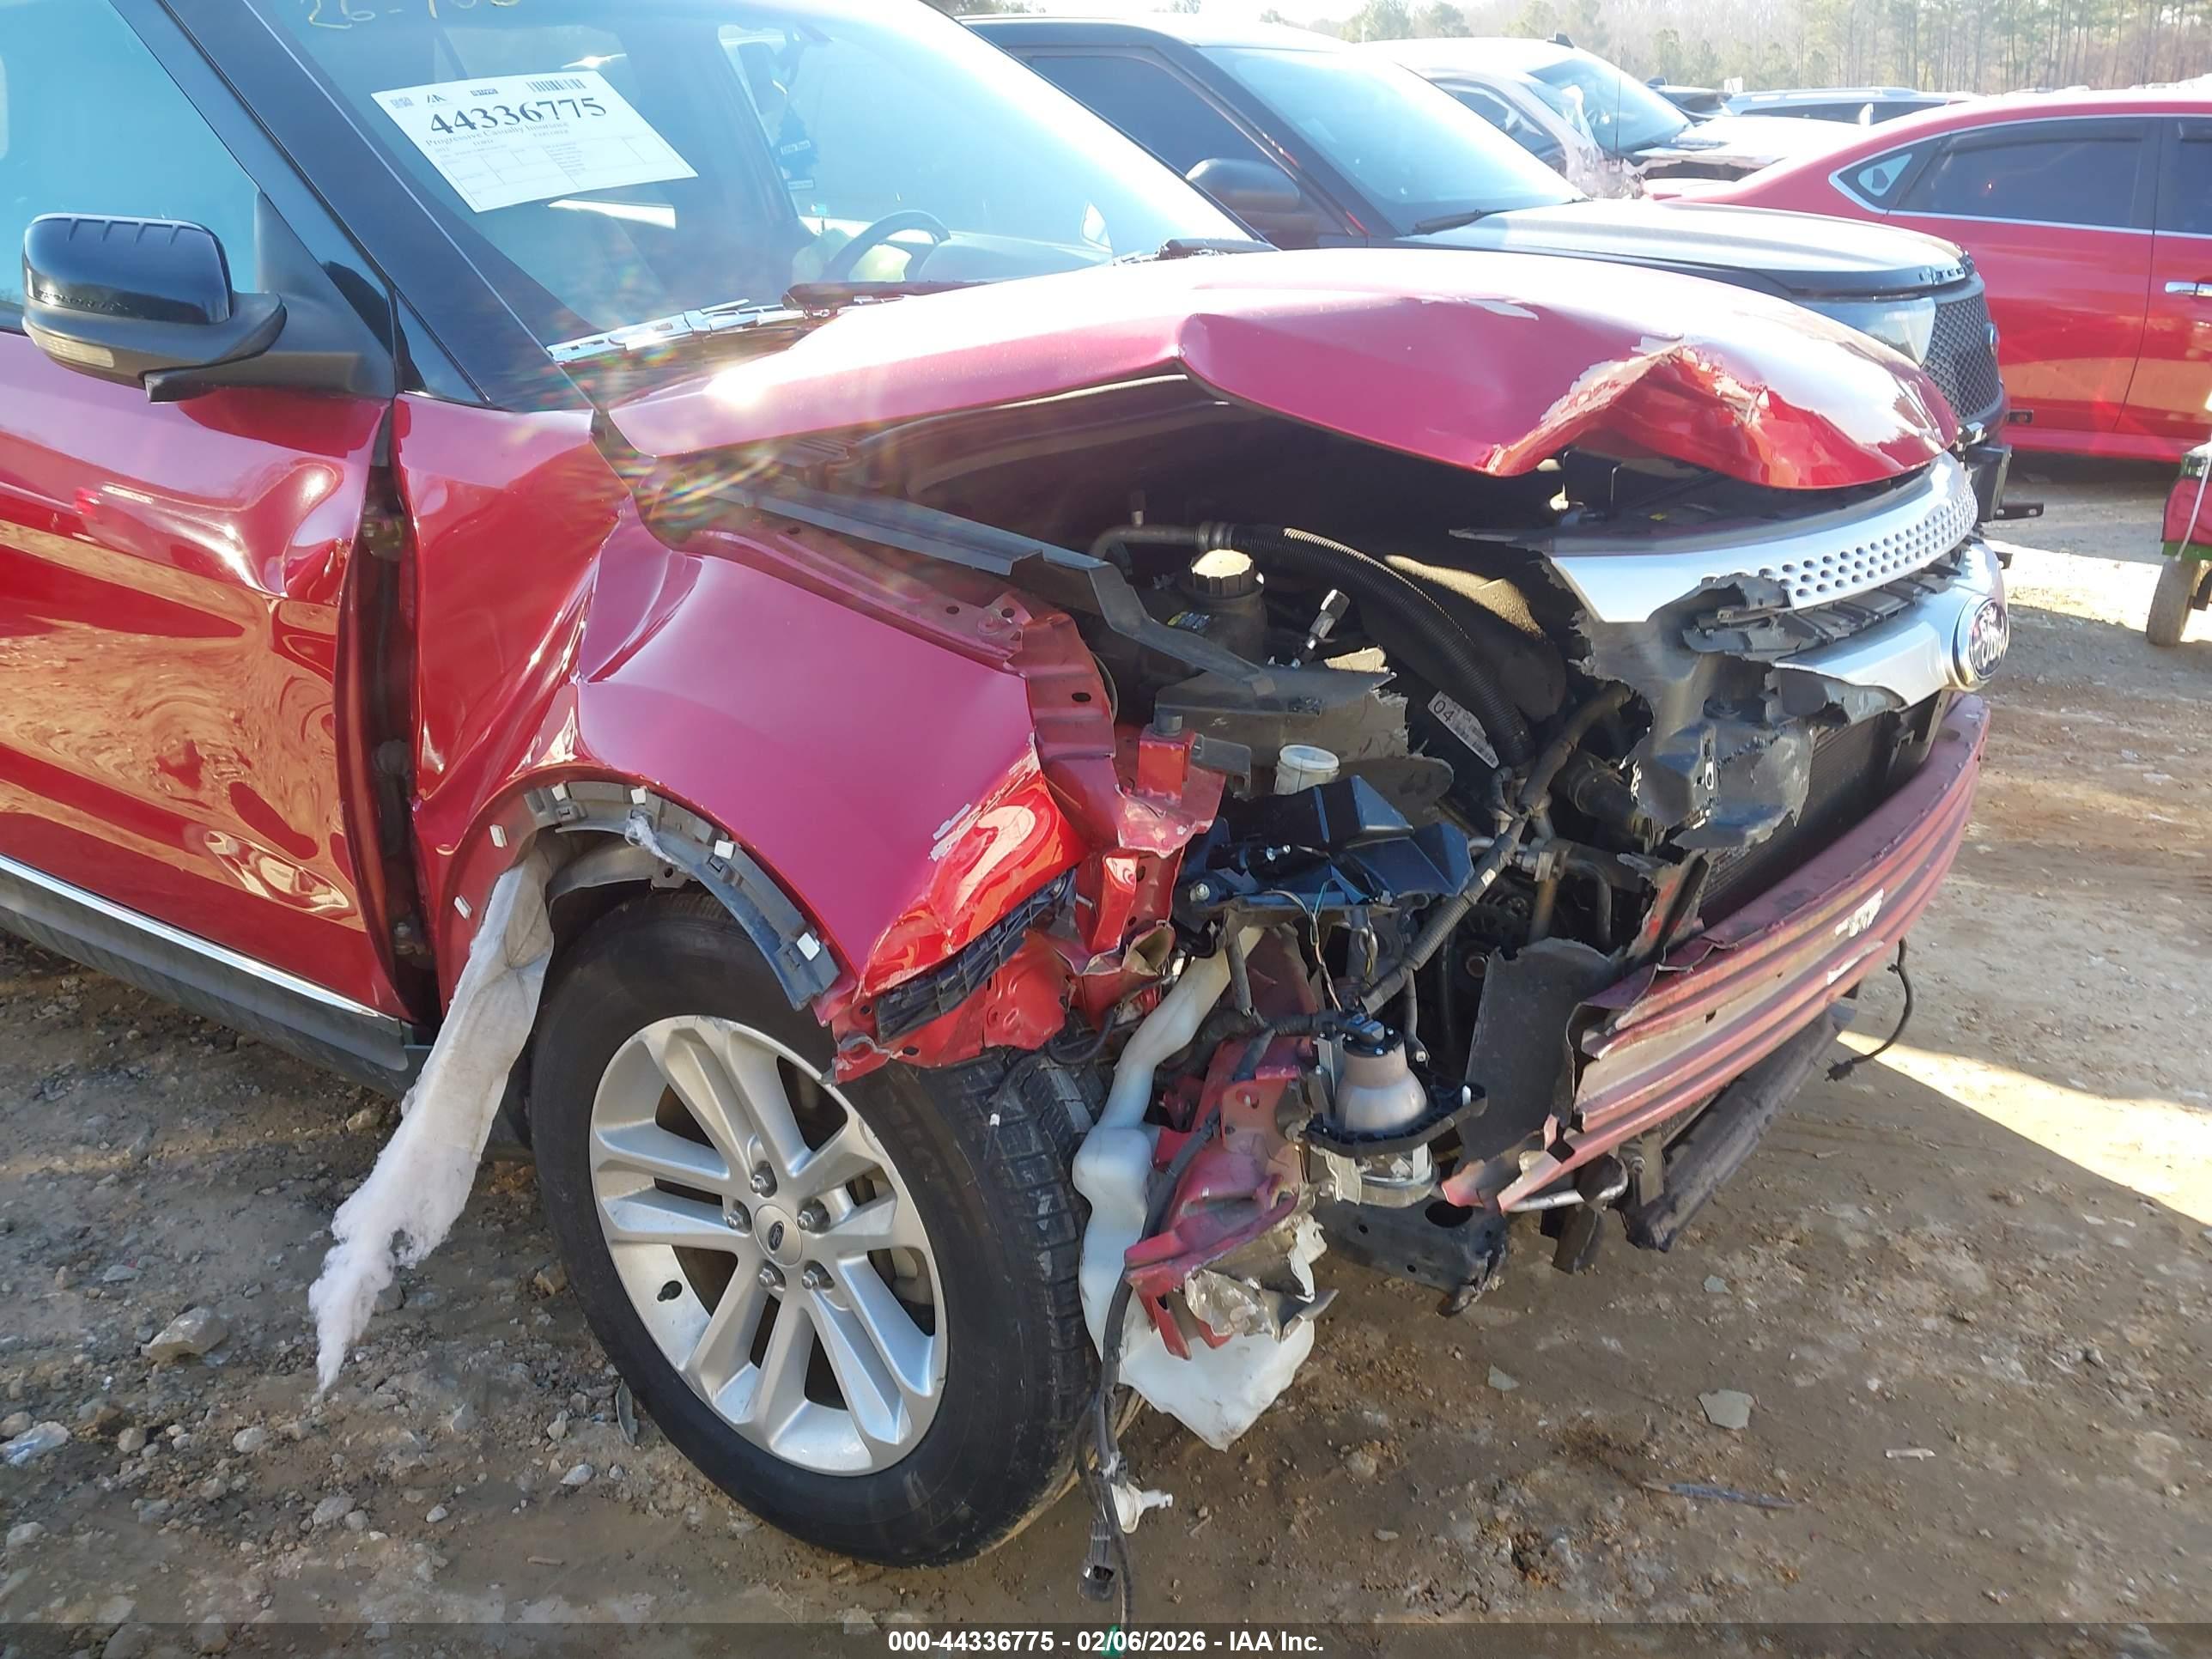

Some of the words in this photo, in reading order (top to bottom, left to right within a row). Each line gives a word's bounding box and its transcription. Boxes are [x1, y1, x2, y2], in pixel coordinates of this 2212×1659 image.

[430, 97, 607, 134] 44336775
[425, 131, 483, 147] Progressive
[483, 125, 525, 138] Casualty
[1433, 700, 1455, 721] 04
